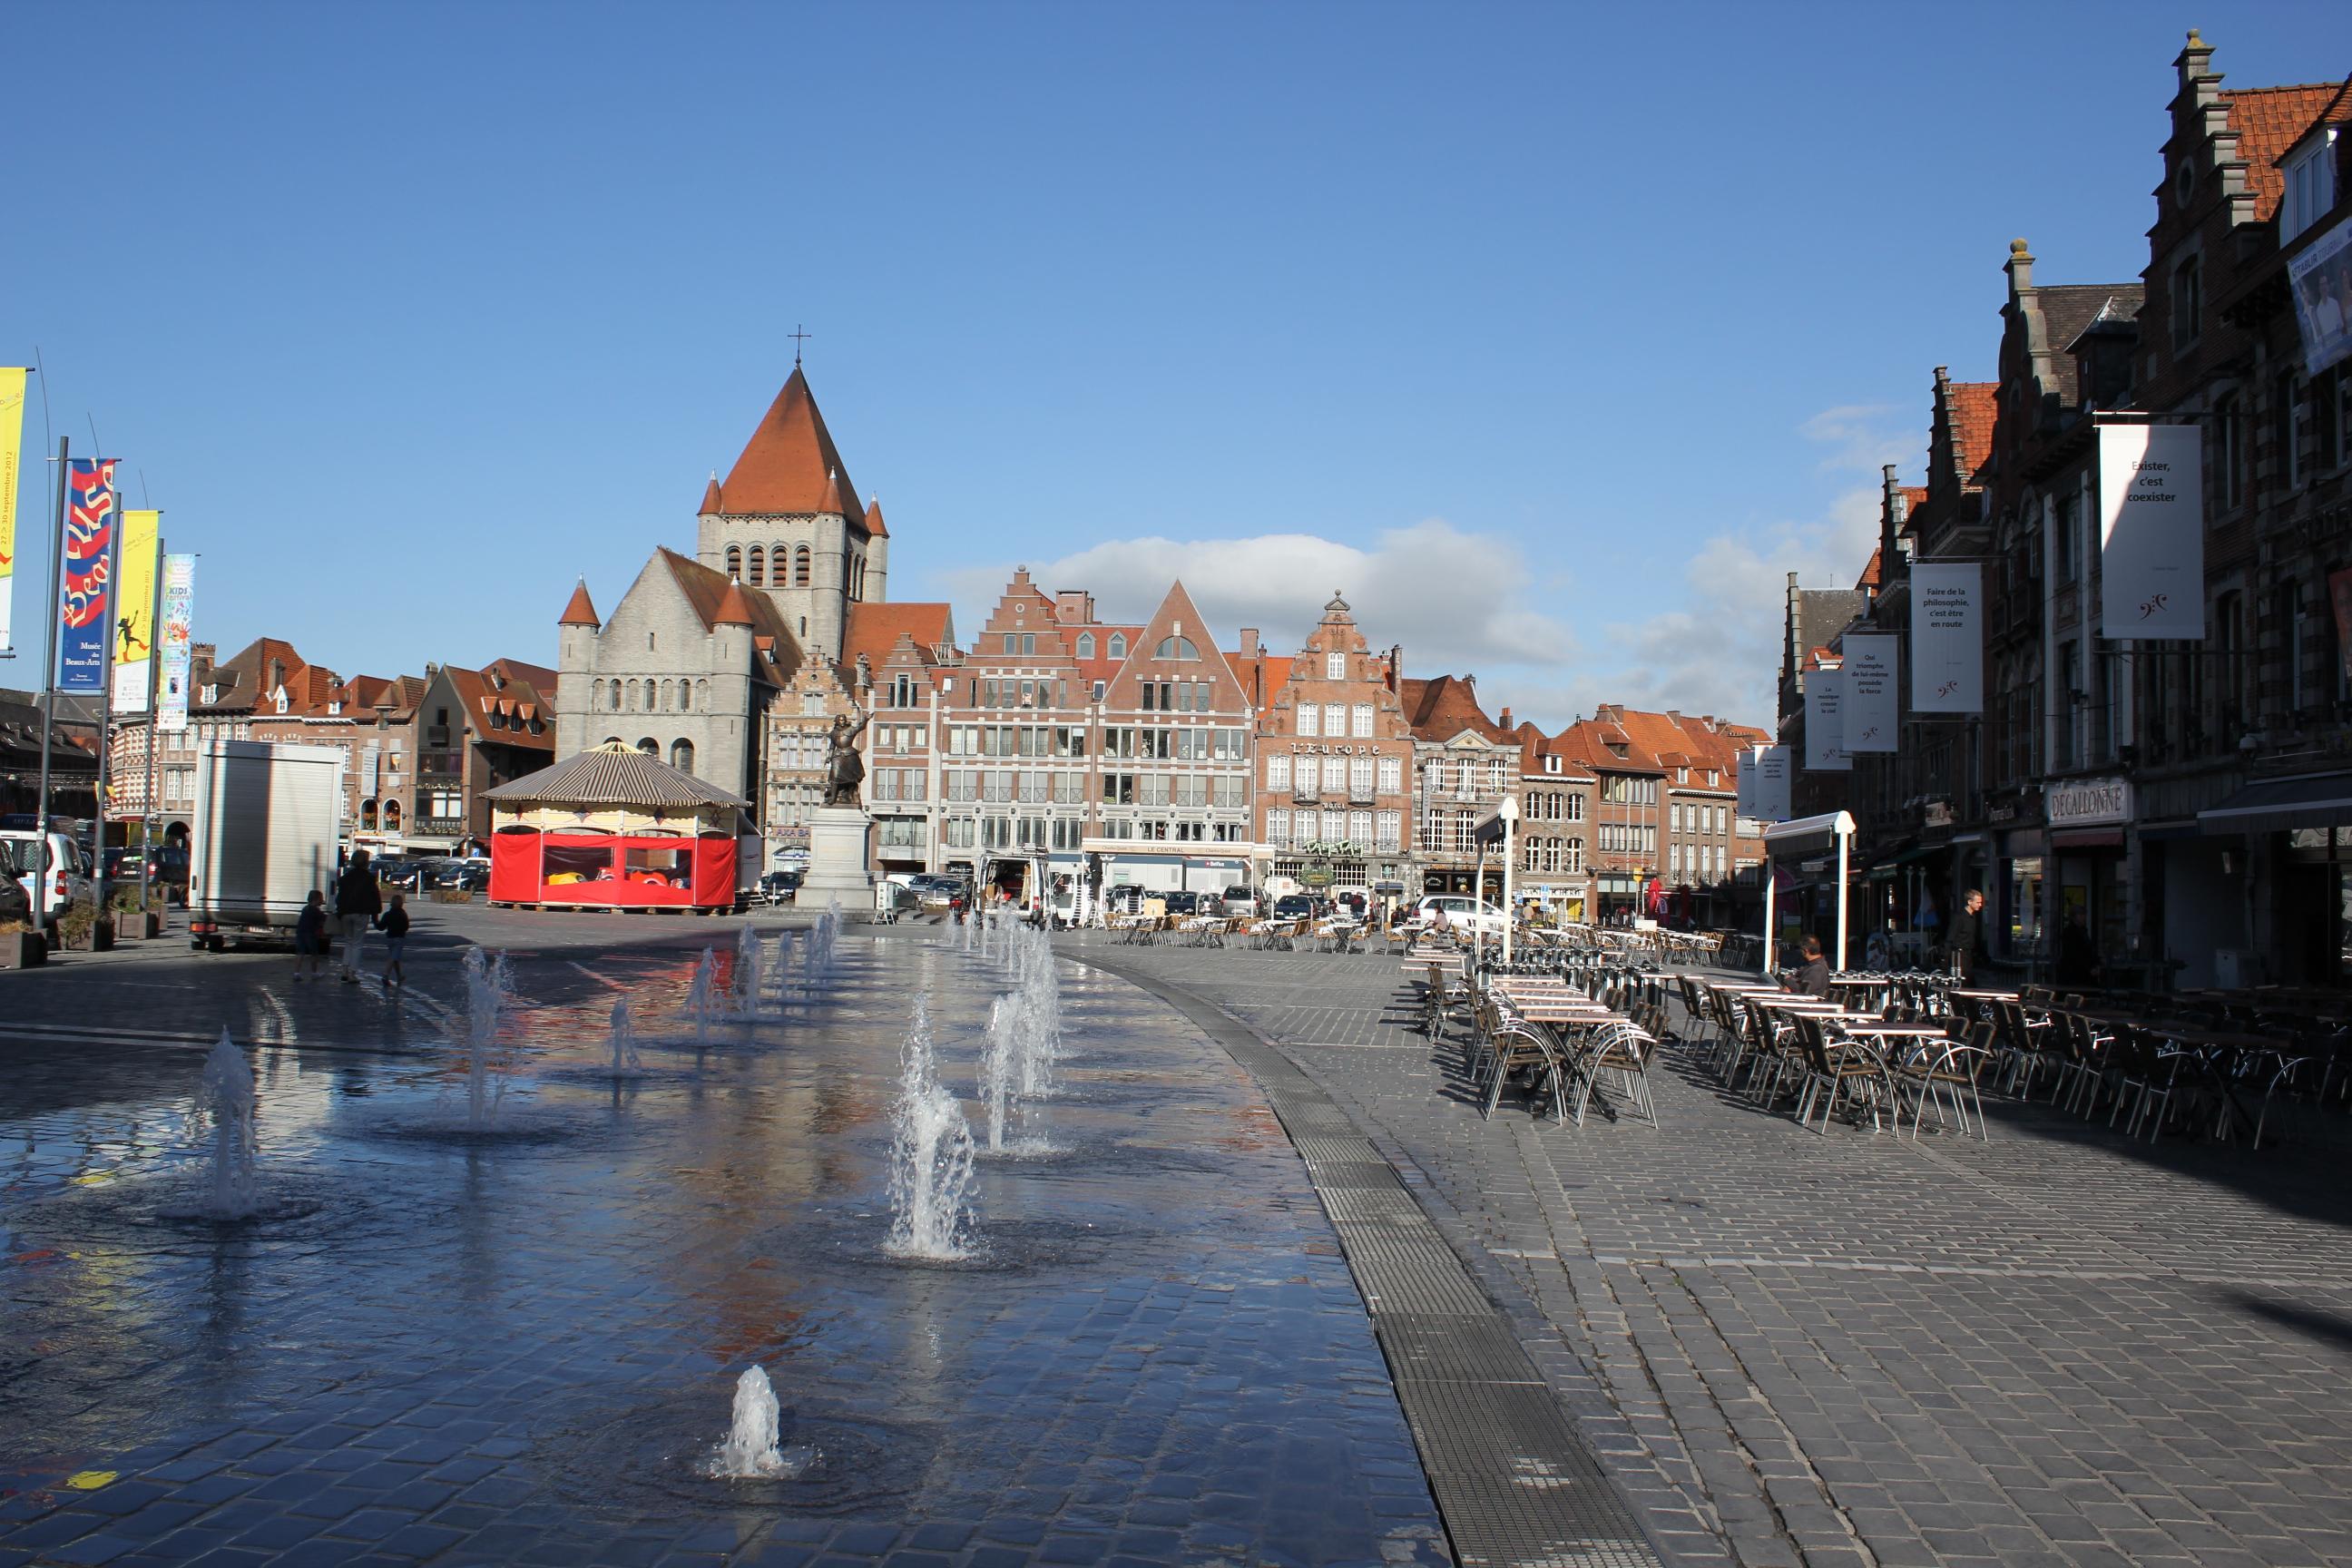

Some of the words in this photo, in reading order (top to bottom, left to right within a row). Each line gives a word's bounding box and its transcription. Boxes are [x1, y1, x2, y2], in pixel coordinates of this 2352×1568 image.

[2132, 461, 2171, 472] Exister,
[2139, 477, 2164, 486] c'est
[4, 471, 13, 514] septembre
[2127, 492, 2176, 502] coexister
[2, 514, 8, 524] 30
[1923, 599, 1970, 607] philosophie,
[1929, 609, 1946, 617] c'est
[1947, 609, 1965, 617] être
[1942, 620, 1963, 628] route
[80, 642, 102, 650] Musée
[65, 658, 101, 666] Beaux-Arts
[1290, 742, 1379, 755] L'Europe
[2053, 788, 2122, 817] DECALLONNE
[777, 828, 795, 837] AXA
